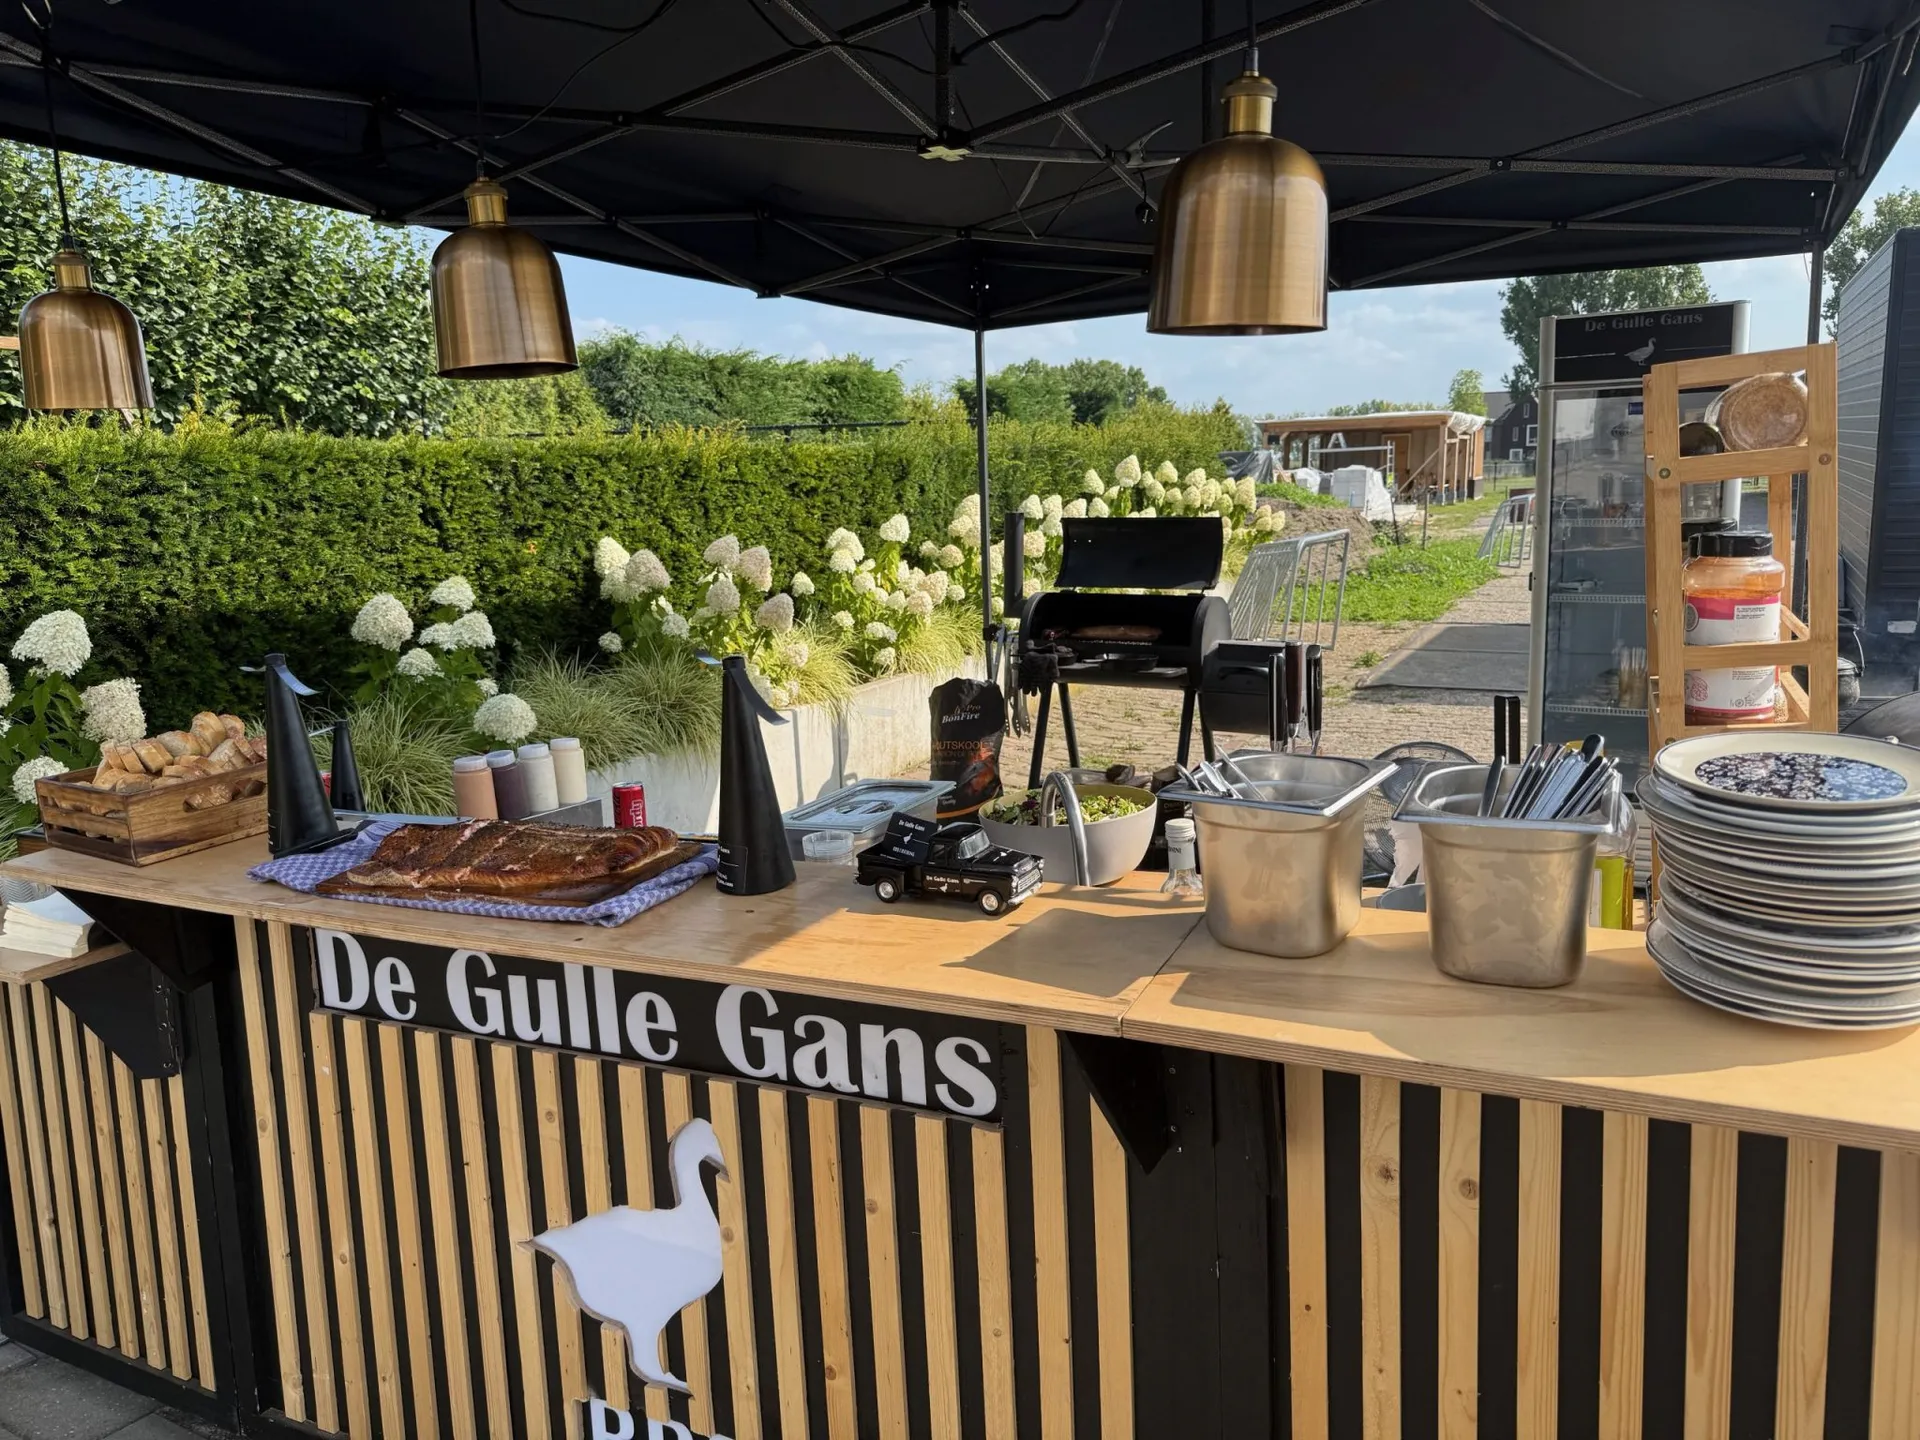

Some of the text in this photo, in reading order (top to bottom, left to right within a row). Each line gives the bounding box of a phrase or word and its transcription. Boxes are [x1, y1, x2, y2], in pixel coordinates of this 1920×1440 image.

[1585, 313, 1703, 332] De Gulle Gans
[942, 712, 980, 724] BonFire
[317, 928, 998, 1117] De Gulle Gans
